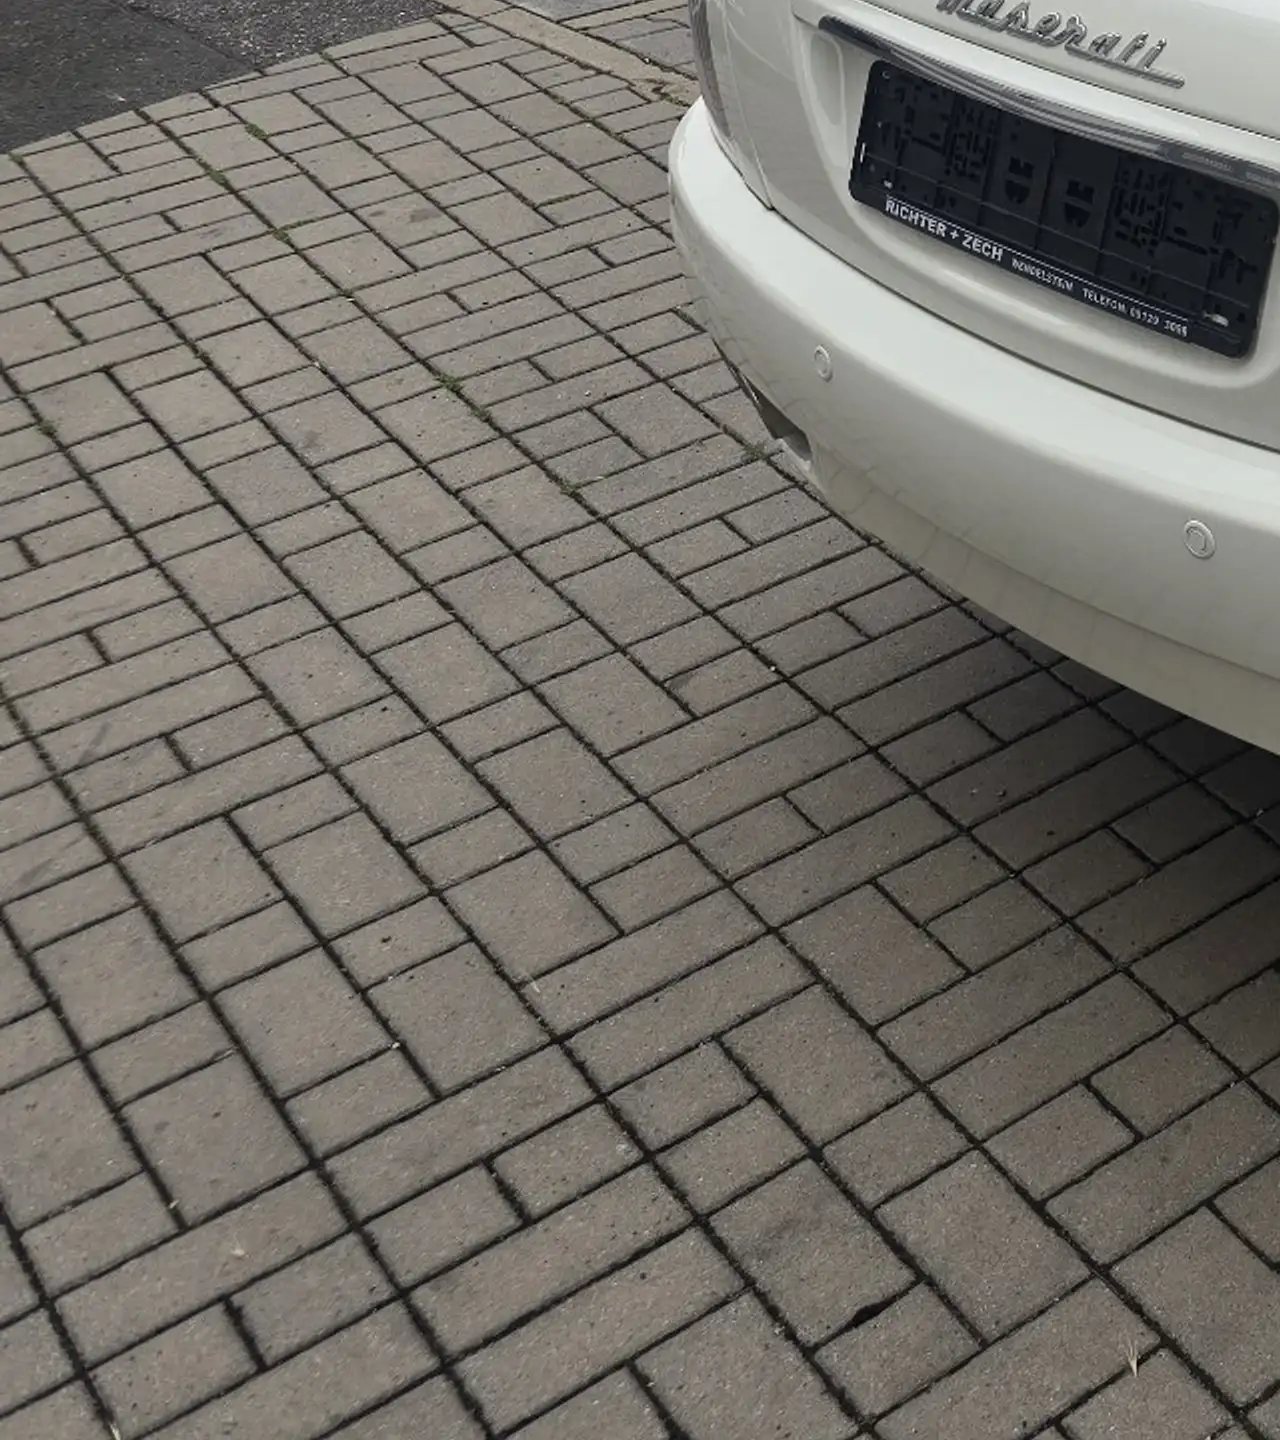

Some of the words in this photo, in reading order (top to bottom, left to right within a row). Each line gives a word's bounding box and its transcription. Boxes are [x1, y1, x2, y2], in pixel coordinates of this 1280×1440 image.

[885, 198, 947, 238] RICHTER
[949, 230, 960, 240] +
[962, 233, 1004, 262] ZECH
[1082, 287, 1127, 314] TELEFON
